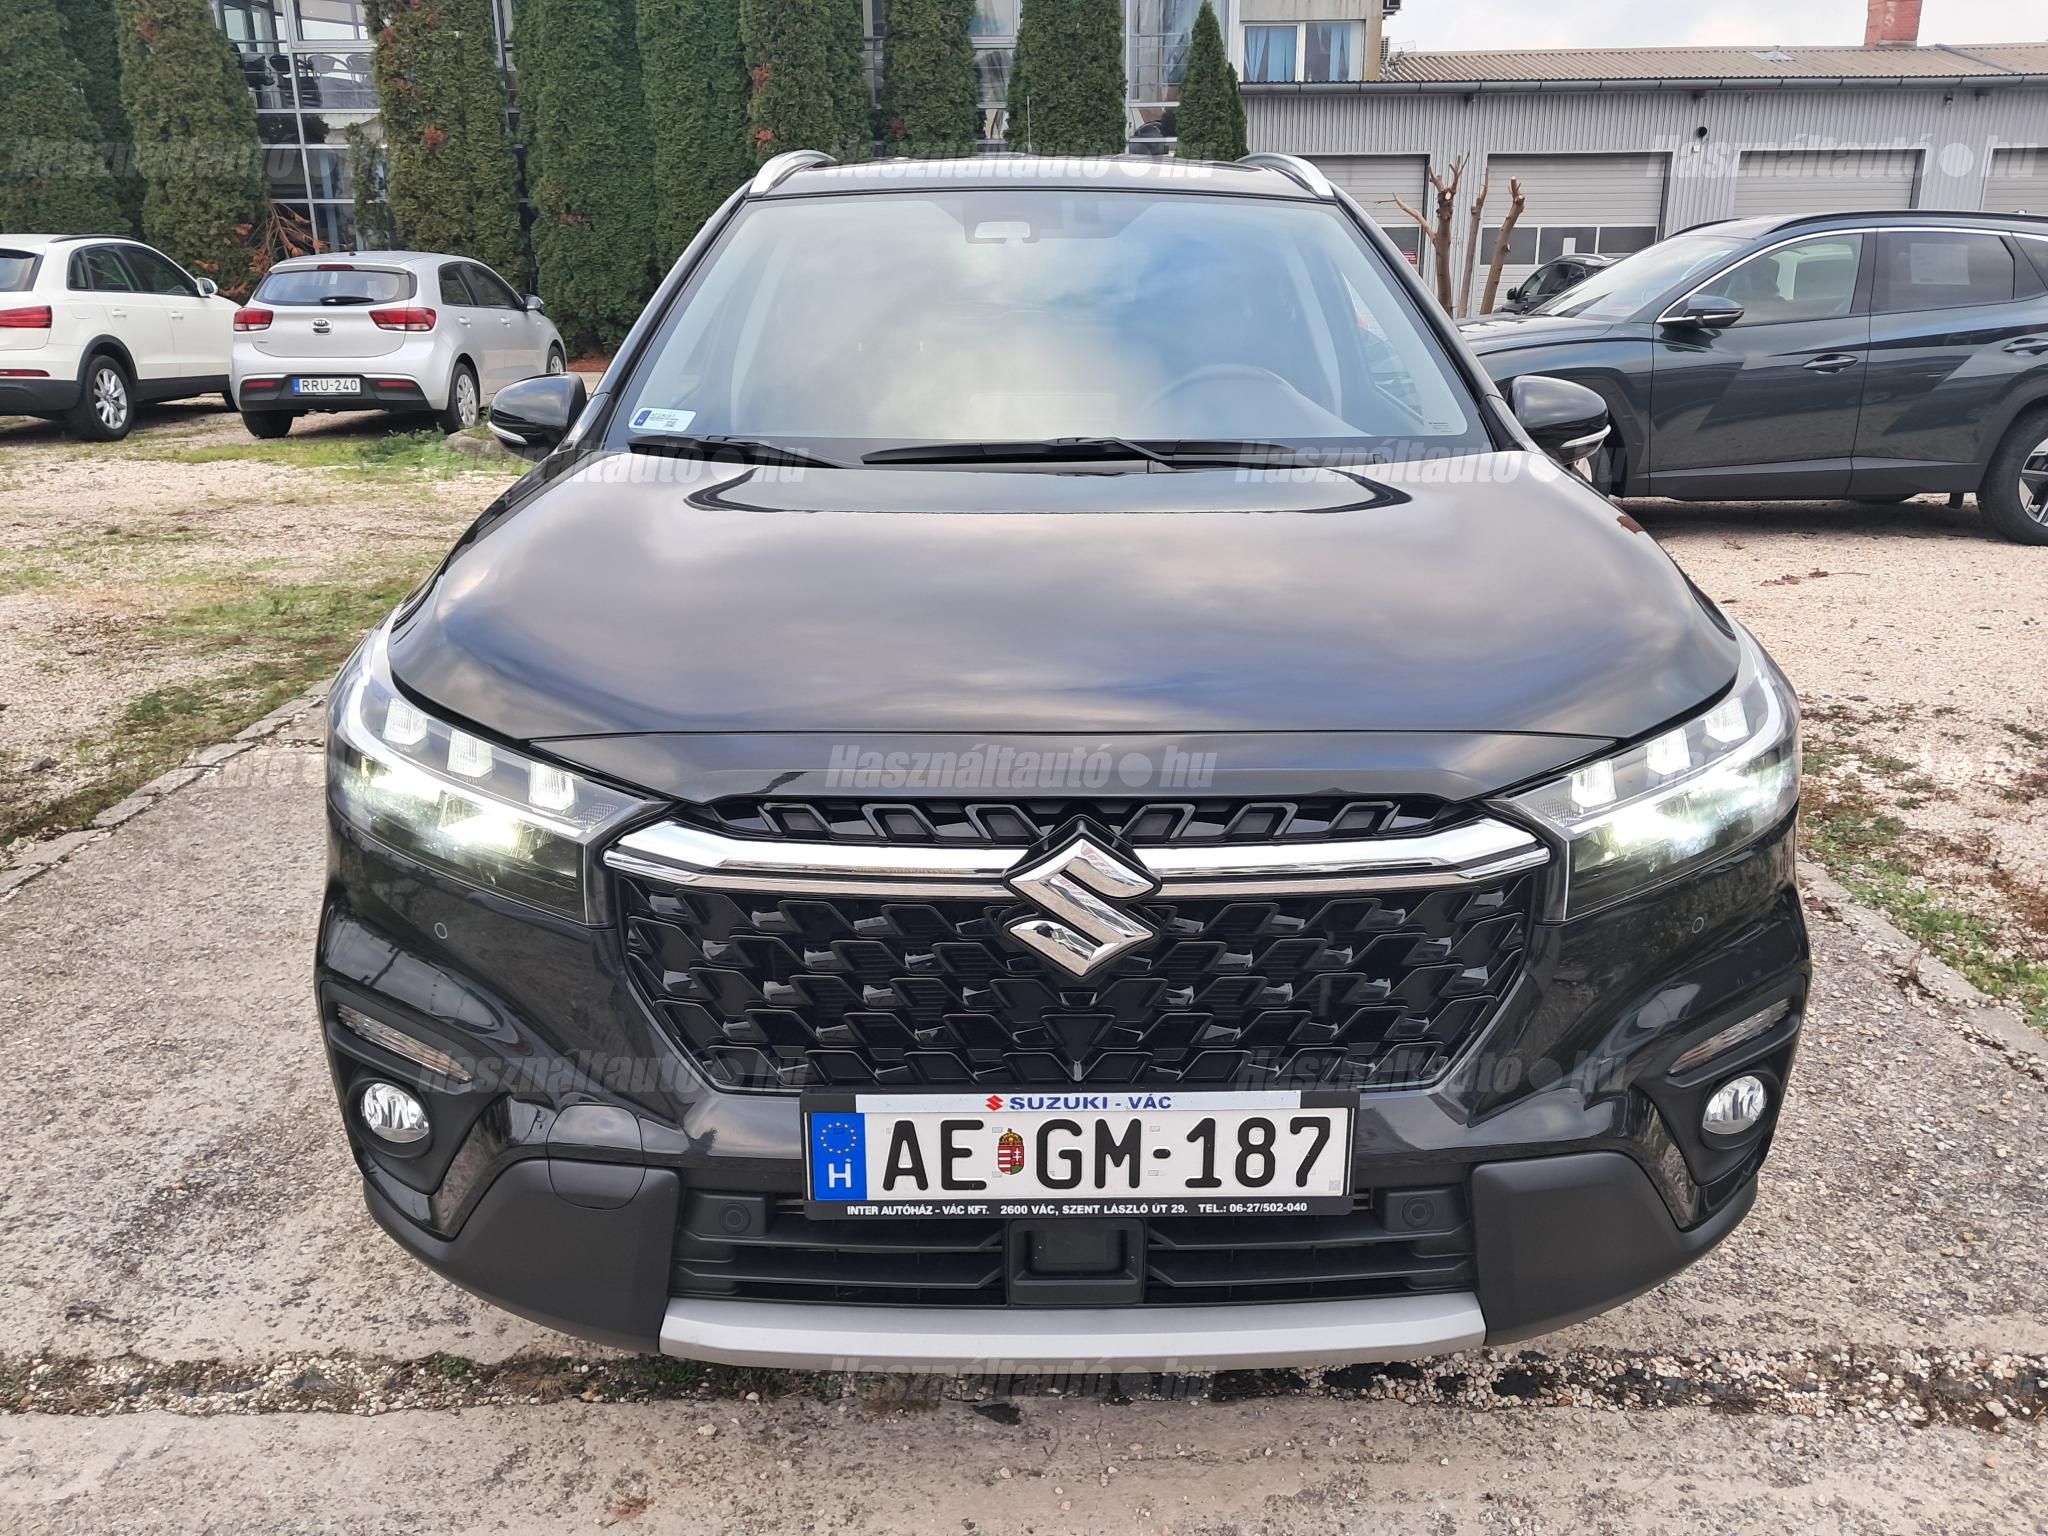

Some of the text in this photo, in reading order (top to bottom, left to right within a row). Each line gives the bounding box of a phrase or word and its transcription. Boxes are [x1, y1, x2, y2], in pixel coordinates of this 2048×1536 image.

[302, 379, 357, 391] RRU-240
[1009, 1096, 1108, 1110] SUZUKI
[1128, 1093, 1172, 1110] VÁC
[883, 1116, 1330, 1191] AE GM-187
[828, 1163, 852, 1188] H
[847, 1205, 879, 1215] INTER
[881, 1203, 933, 1215] AUTÓHÁZ
[942, 1203, 965, 1215] VÁC
[967, 1205, 990, 1215] KFT.
[1000, 1205, 1028, 1215] 2600
[1031, 1202, 1059, 1216] VÁC,
[1062, 1204, 1100, 1214] SZENT
[1103, 1202, 1148, 1214] LÁSZLÓ
[1152, 1202, 1168, 1214] ÚT
[1171, 1204, 1188, 1213] 29.
[1198, 1203, 1227, 1213] TEL.:
[1229, 1202, 1307, 1213] 06-27/502-040
